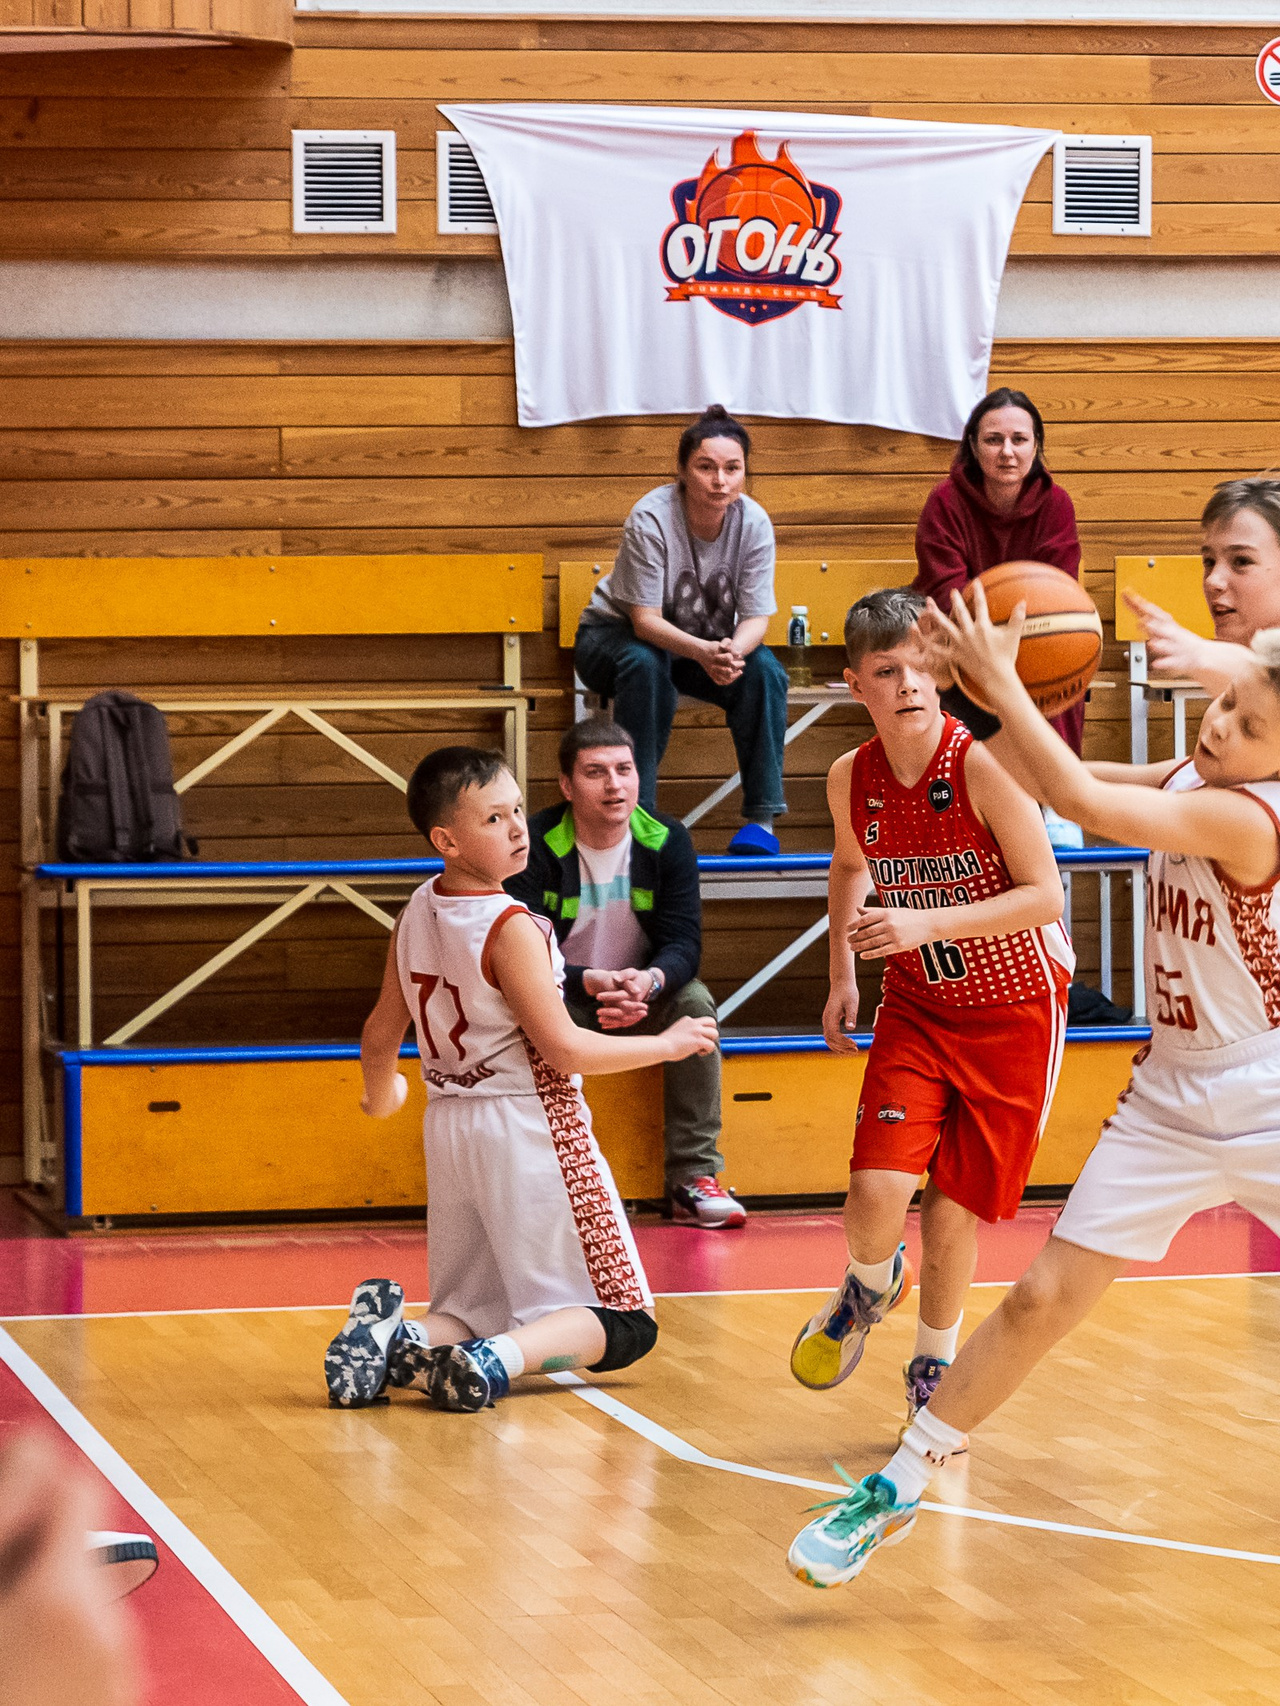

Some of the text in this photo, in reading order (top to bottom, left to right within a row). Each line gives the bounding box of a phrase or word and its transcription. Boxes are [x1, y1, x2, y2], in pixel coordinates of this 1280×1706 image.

[665, 216, 836, 283] ОГОНЬ
[865, 849, 983, 886] ПОРТИВНАЯ
[919, 937, 969, 984] 16
